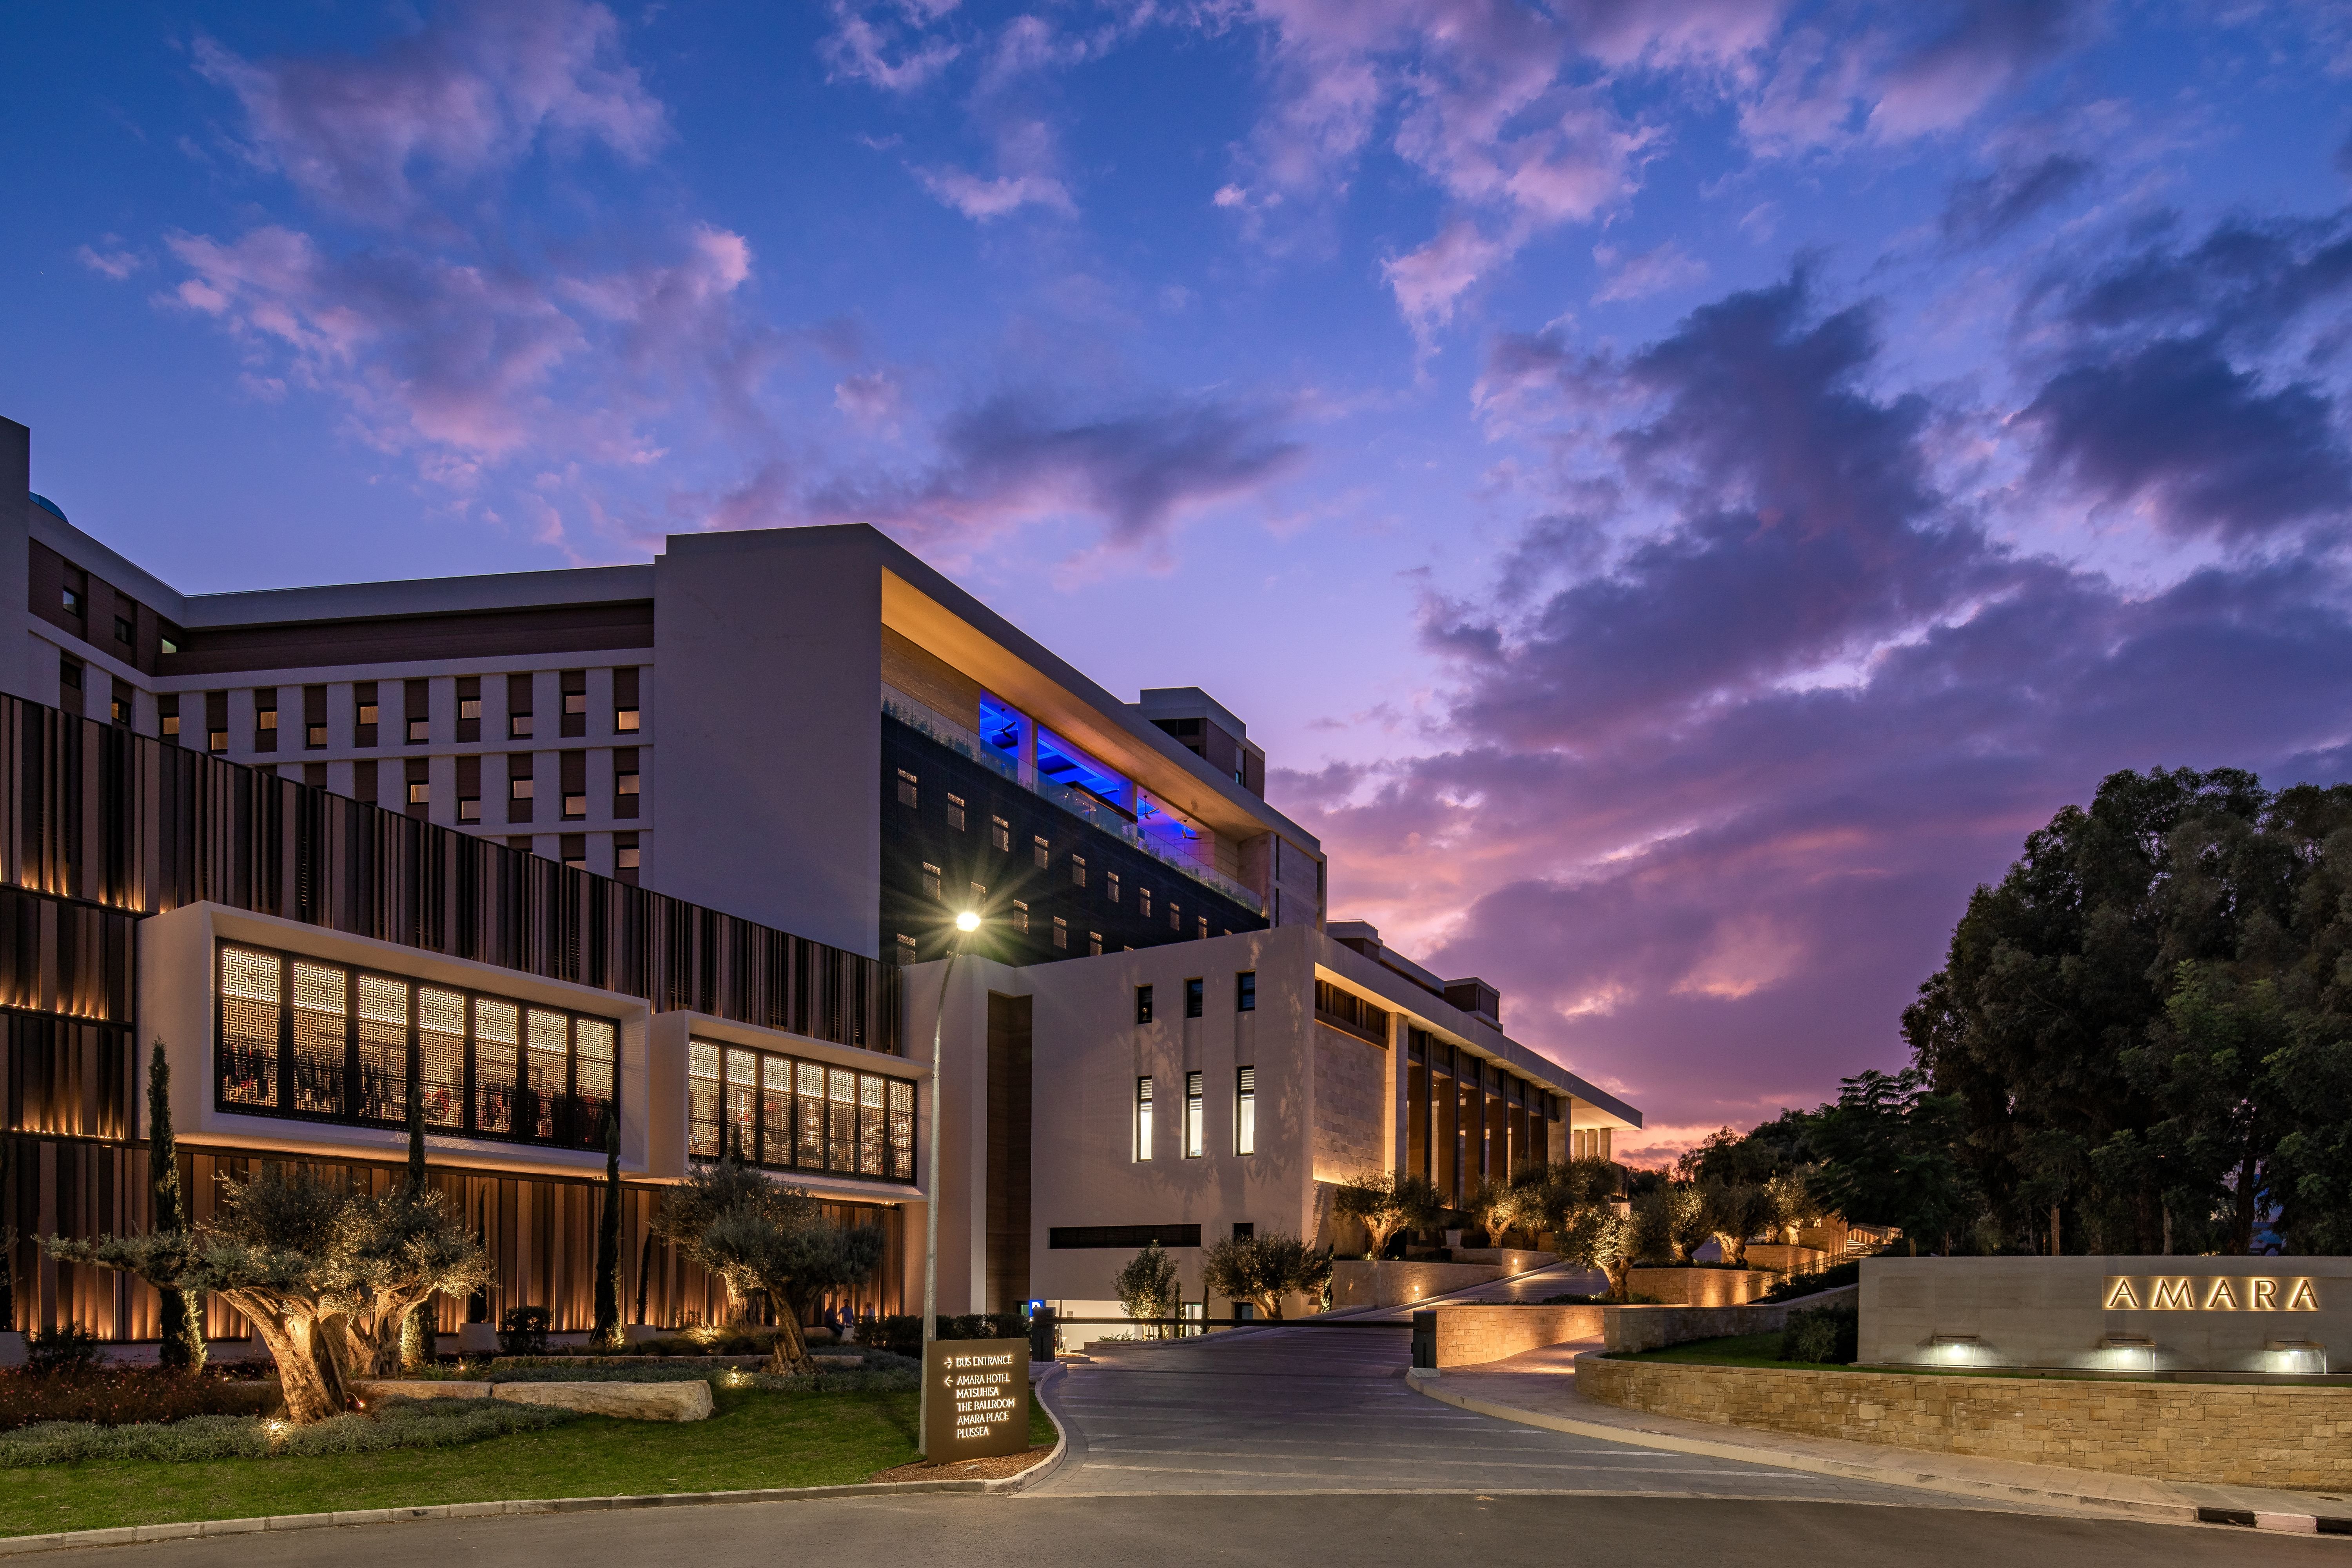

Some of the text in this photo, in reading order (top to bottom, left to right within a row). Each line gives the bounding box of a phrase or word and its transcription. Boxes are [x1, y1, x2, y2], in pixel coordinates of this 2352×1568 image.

[2108, 1279, 2319, 1308] AMARA
[956, 1356, 1012, 1367] BUS ENTRANCE
[957, 1373, 1010, 1386] AMARA HOTEL
[956, 1387, 999, 1399] MATSUHISA
[957, 1398, 1014, 1412] THE BALLROOM
[957, 1412, 1009, 1425] AMARA PLACE
[957, 1426, 989, 1439] PLUSSEA
